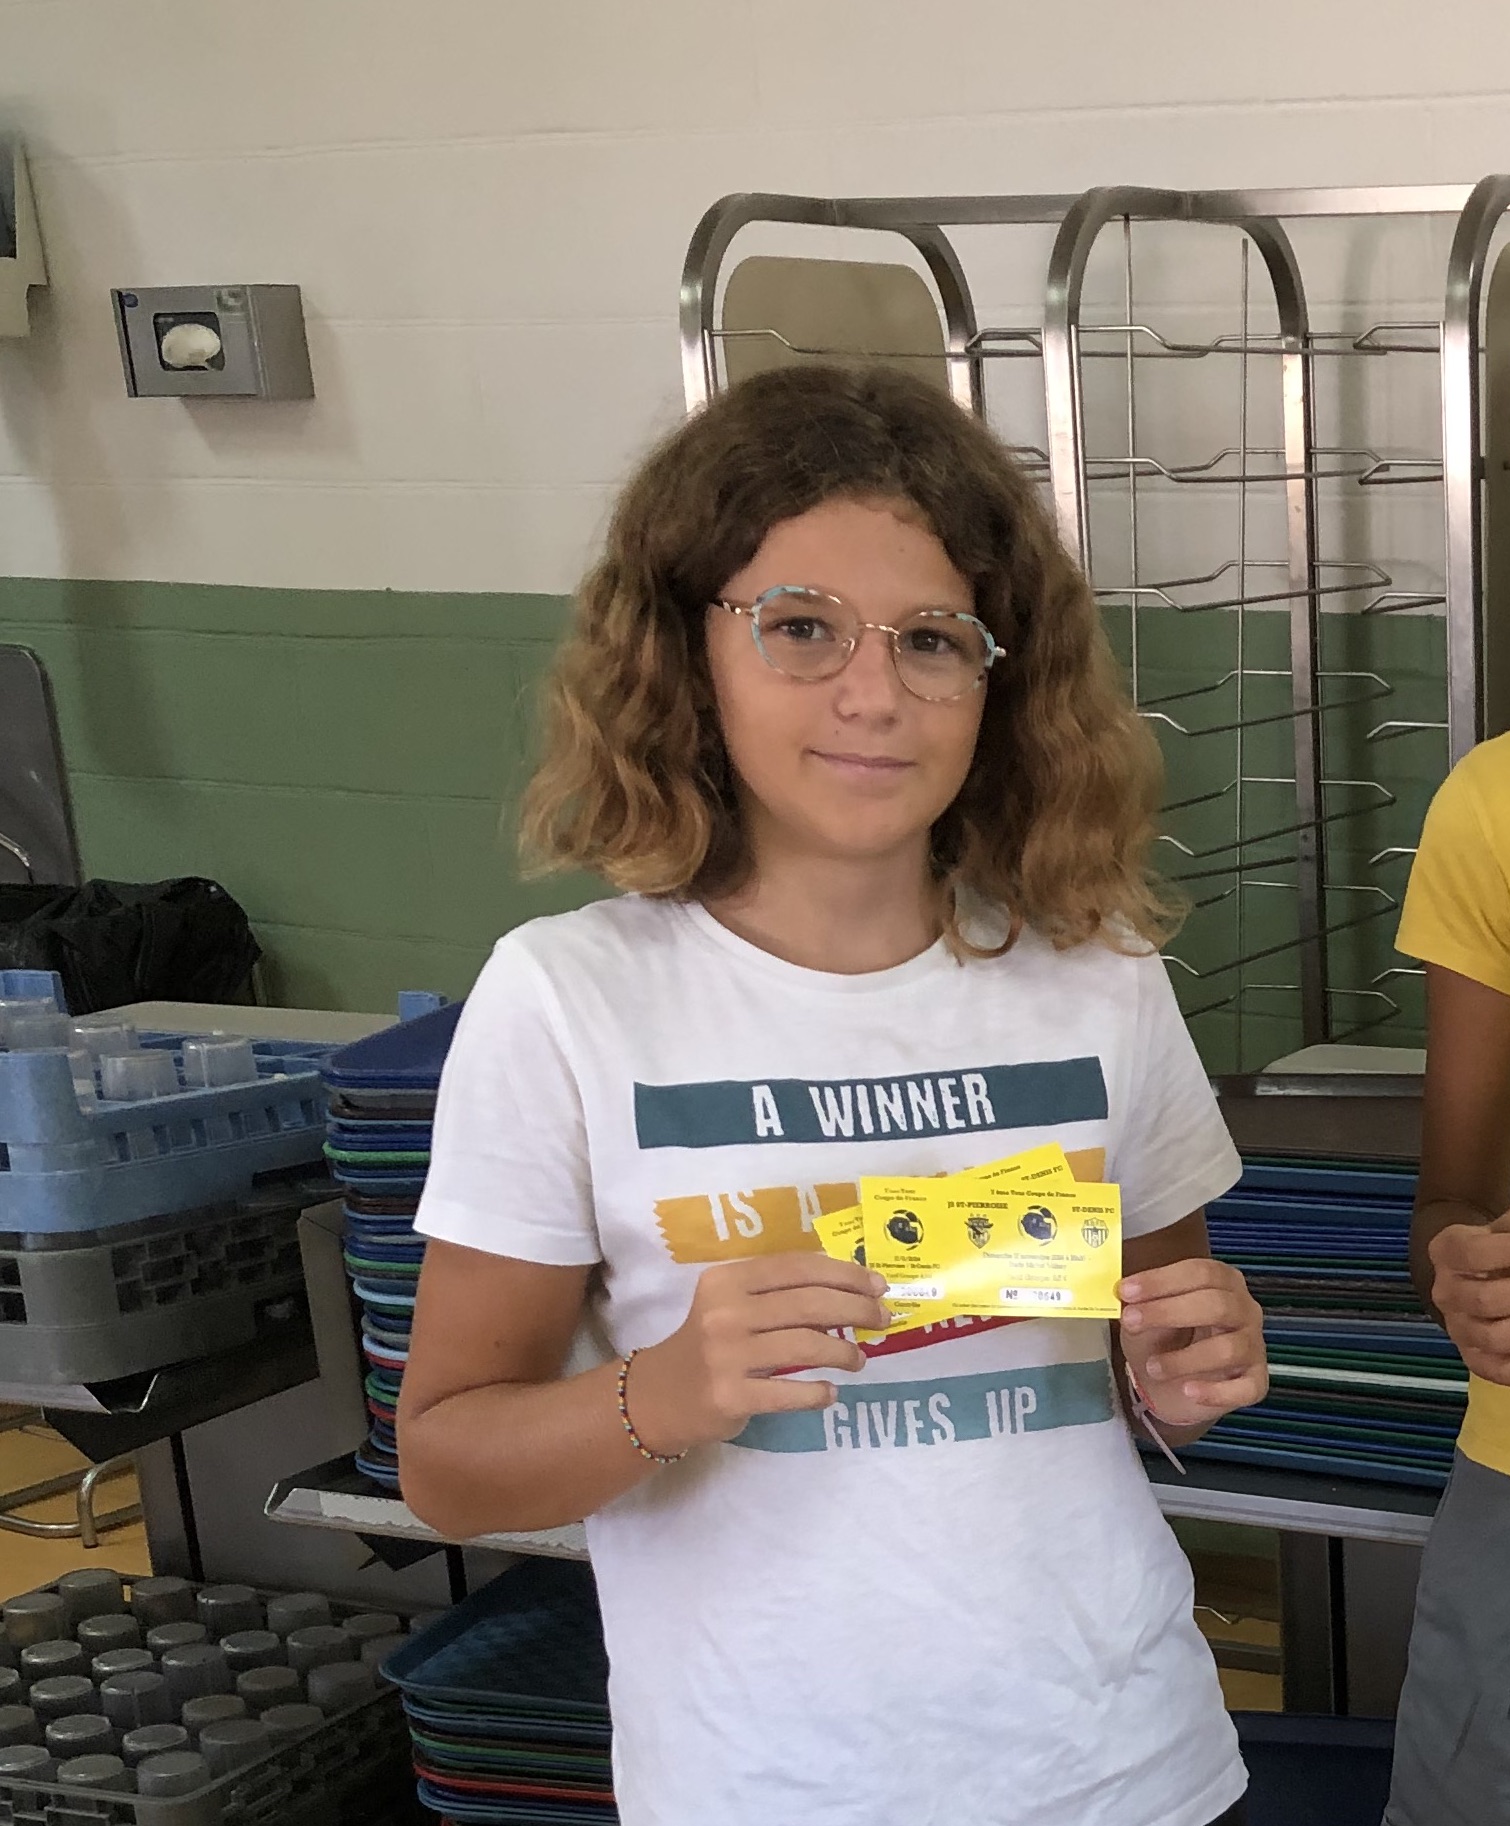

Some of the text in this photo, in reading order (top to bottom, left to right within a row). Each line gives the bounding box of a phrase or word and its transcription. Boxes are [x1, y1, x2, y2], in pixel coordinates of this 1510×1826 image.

[751, 1072, 996, 1138] A WINNER
[705, 1188, 764, 1242] IS
[822, 1385, 1038, 1450] GIVES UP
